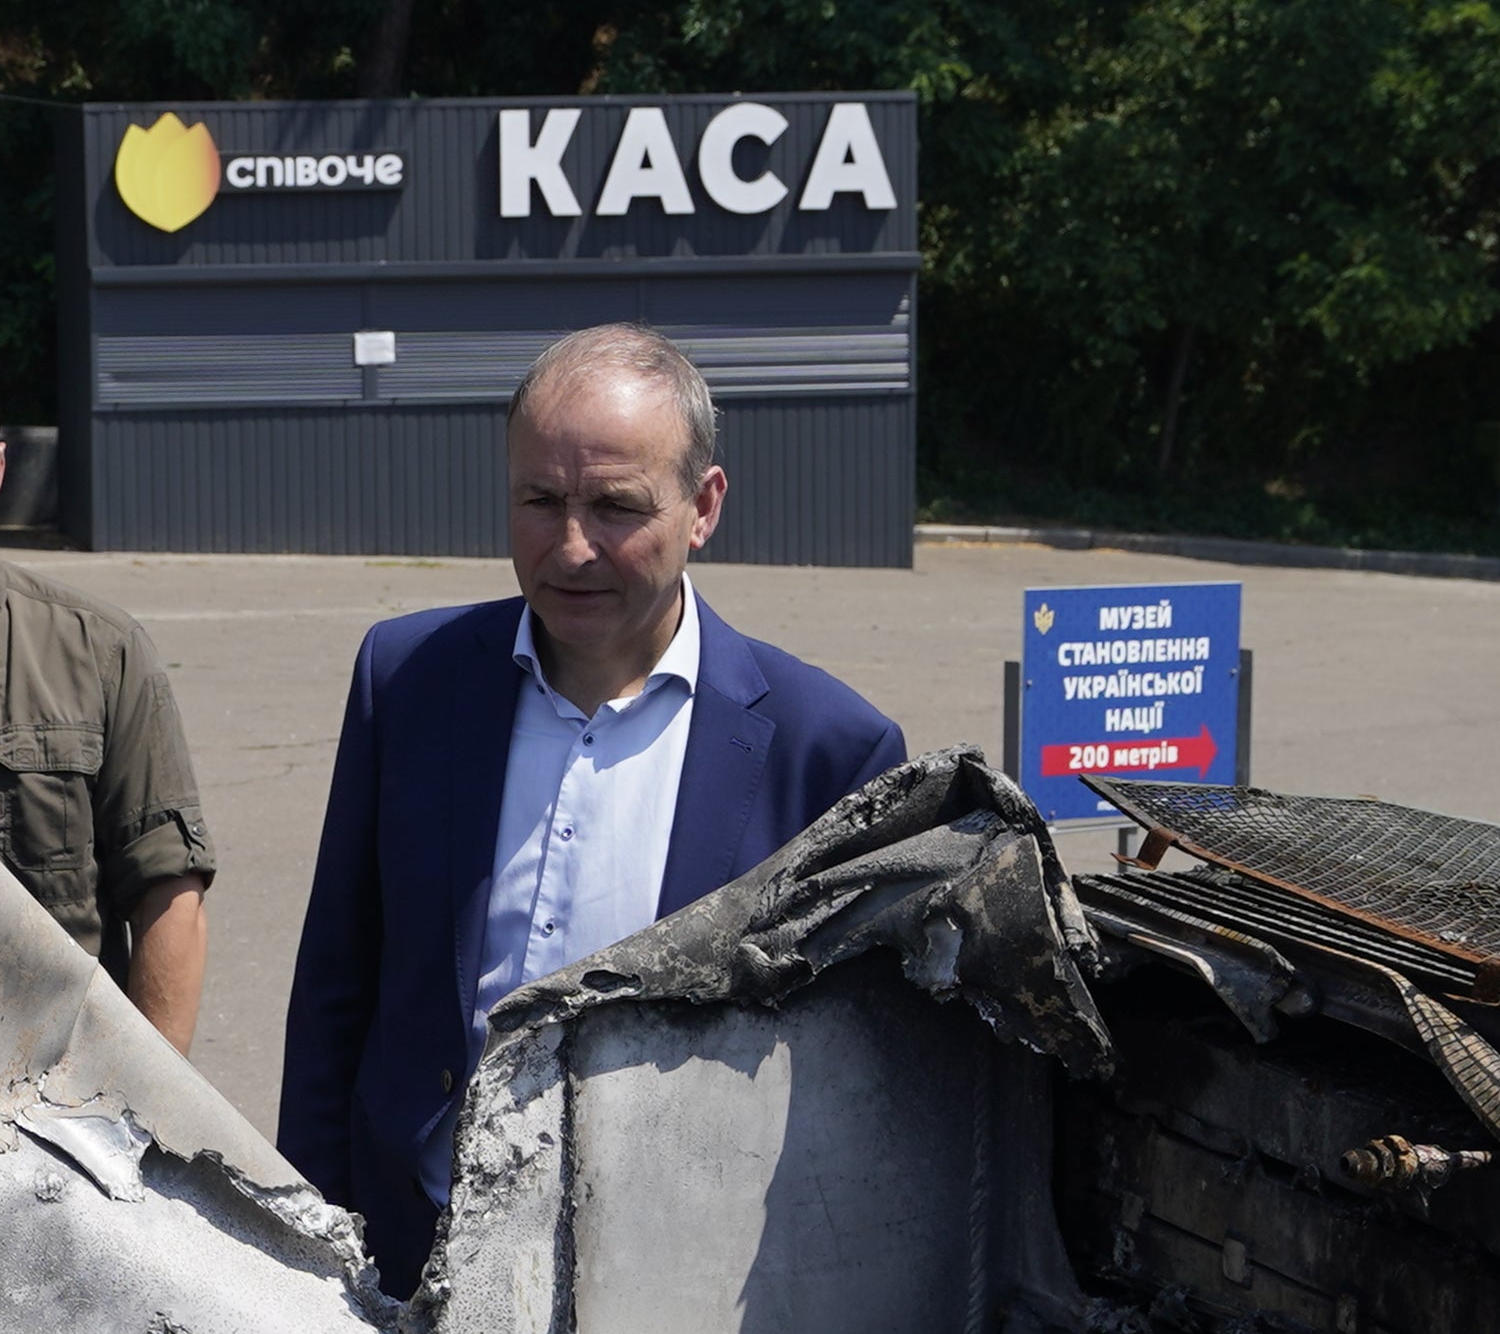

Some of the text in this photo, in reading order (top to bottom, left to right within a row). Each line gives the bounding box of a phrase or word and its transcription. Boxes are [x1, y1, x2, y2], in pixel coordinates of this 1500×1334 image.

[499, 102, 898, 218] КАСА
[1099, 600, 1172, 630] МУЗЕЙ
[1058, 637, 1210, 666] СТАНОВЛЕННЯ
[1063, 666, 1204, 700] УКРАЇНСЬКОЇ
[1105, 702, 1164, 733] НАЦІЇ
[1069, 741, 1178, 770] 200 метрів
